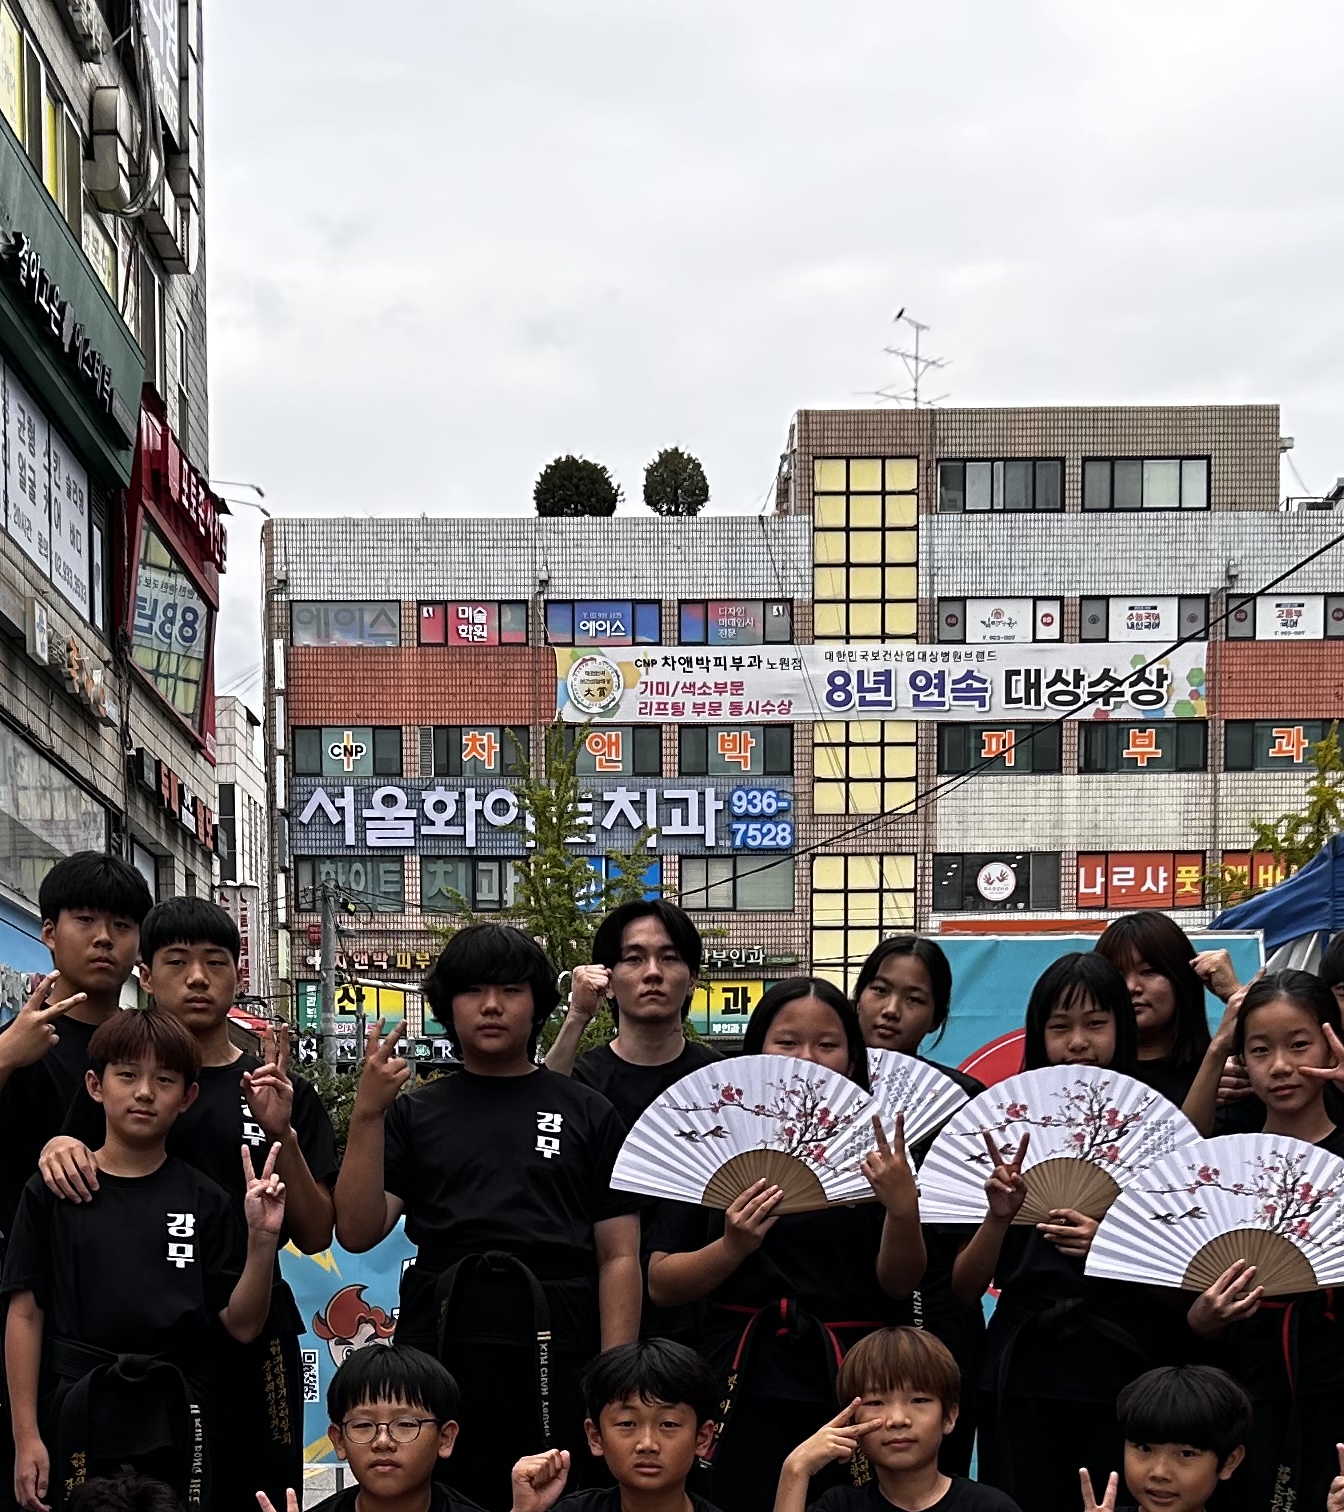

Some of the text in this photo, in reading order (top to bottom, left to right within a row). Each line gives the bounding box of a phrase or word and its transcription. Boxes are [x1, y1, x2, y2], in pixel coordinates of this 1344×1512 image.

[456, 605, 488, 624] 미술
[456, 623, 488, 643] 학원
[578, 620, 626, 637] 에이스
[661, 655, 763, 673] 차앤박피부과
[766, 658, 803, 672] 노원점
[638, 680, 745, 697] 기미/색소부문
[825, 666, 1169, 709] 8년 연속 대상수상
[637, 700, 793, 717] 리프팅 부문 동시수상
[462, 731, 500, 769] 차
[586, 731, 623, 771] 앤
[717, 730, 754, 770] 박
[981, 729, 1015, 767] 피
[1122, 728, 1163, 767] 부
[1269, 726, 1310, 763] 과
[731, 790, 789, 815] 936-
[731, 822, 792, 847] 7528
[720, 986, 752, 1016] 과
[536, 1110, 564, 1160] 강무
[165, 1211, 196, 1269] 강무
